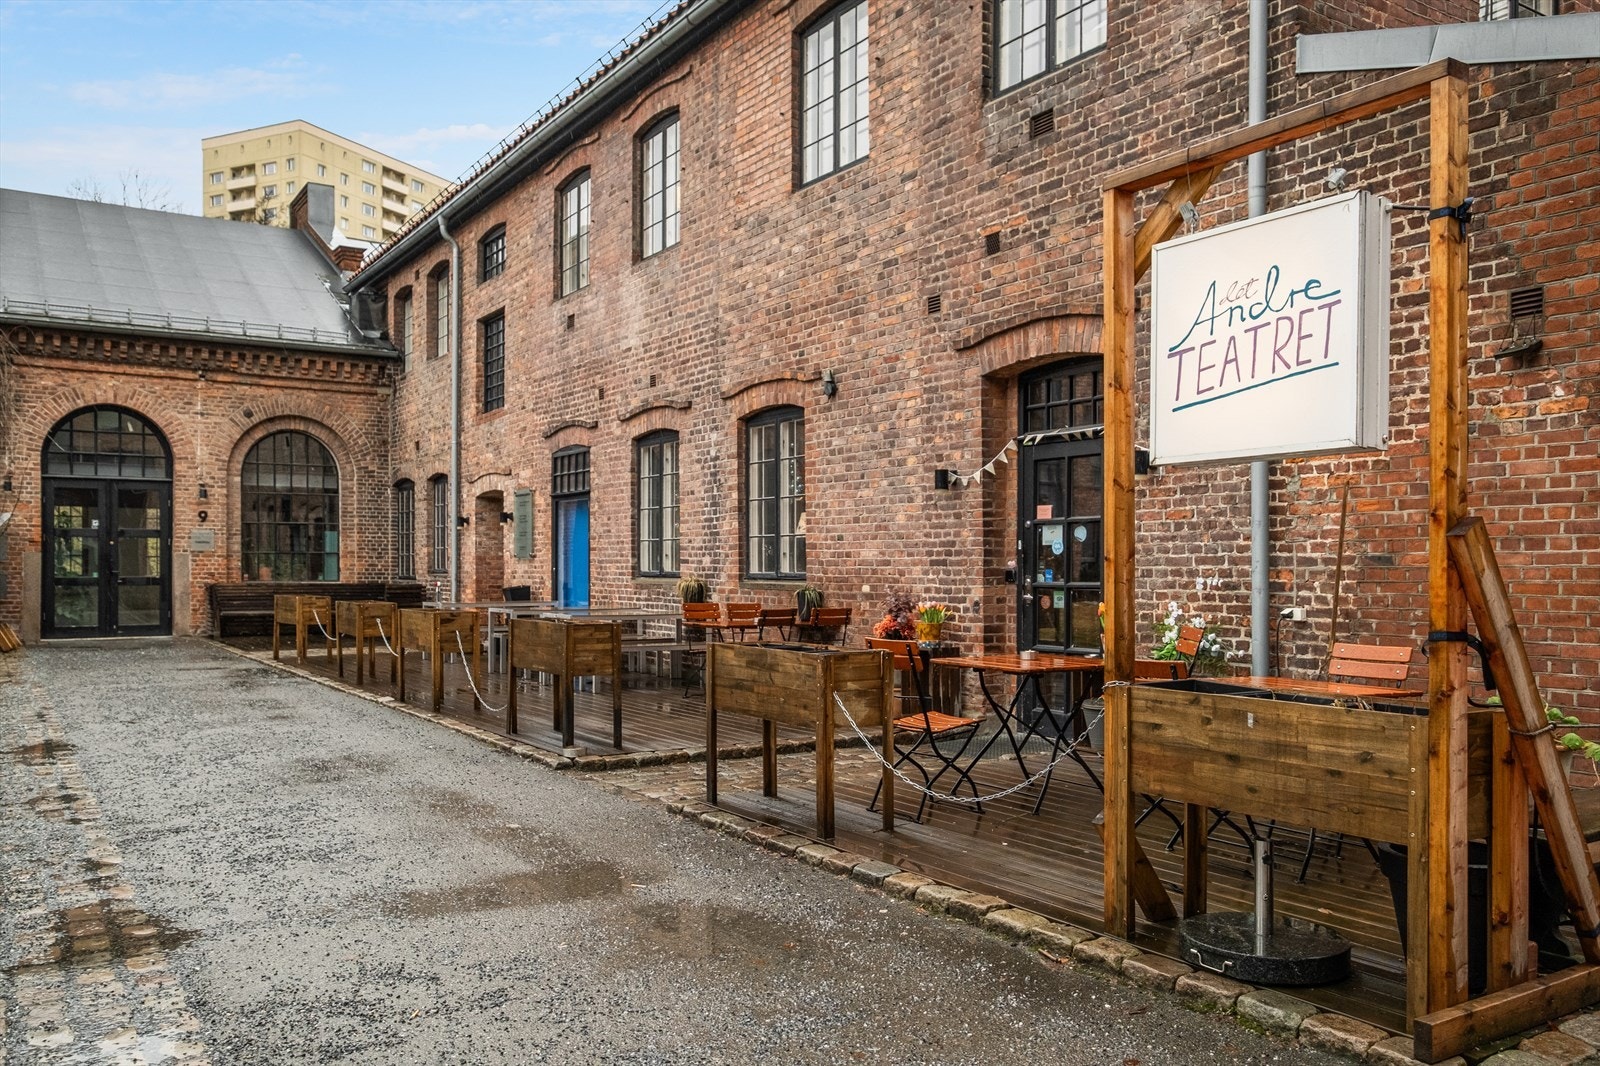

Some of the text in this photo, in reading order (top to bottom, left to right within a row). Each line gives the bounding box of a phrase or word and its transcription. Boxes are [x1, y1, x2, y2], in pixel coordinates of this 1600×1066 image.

[1168, 265, 1341, 352] Andre
[1219, 278, 1259, 306] det
[1168, 300, 1341, 401] TEATRET
[198, 510, 208, 523] 9
